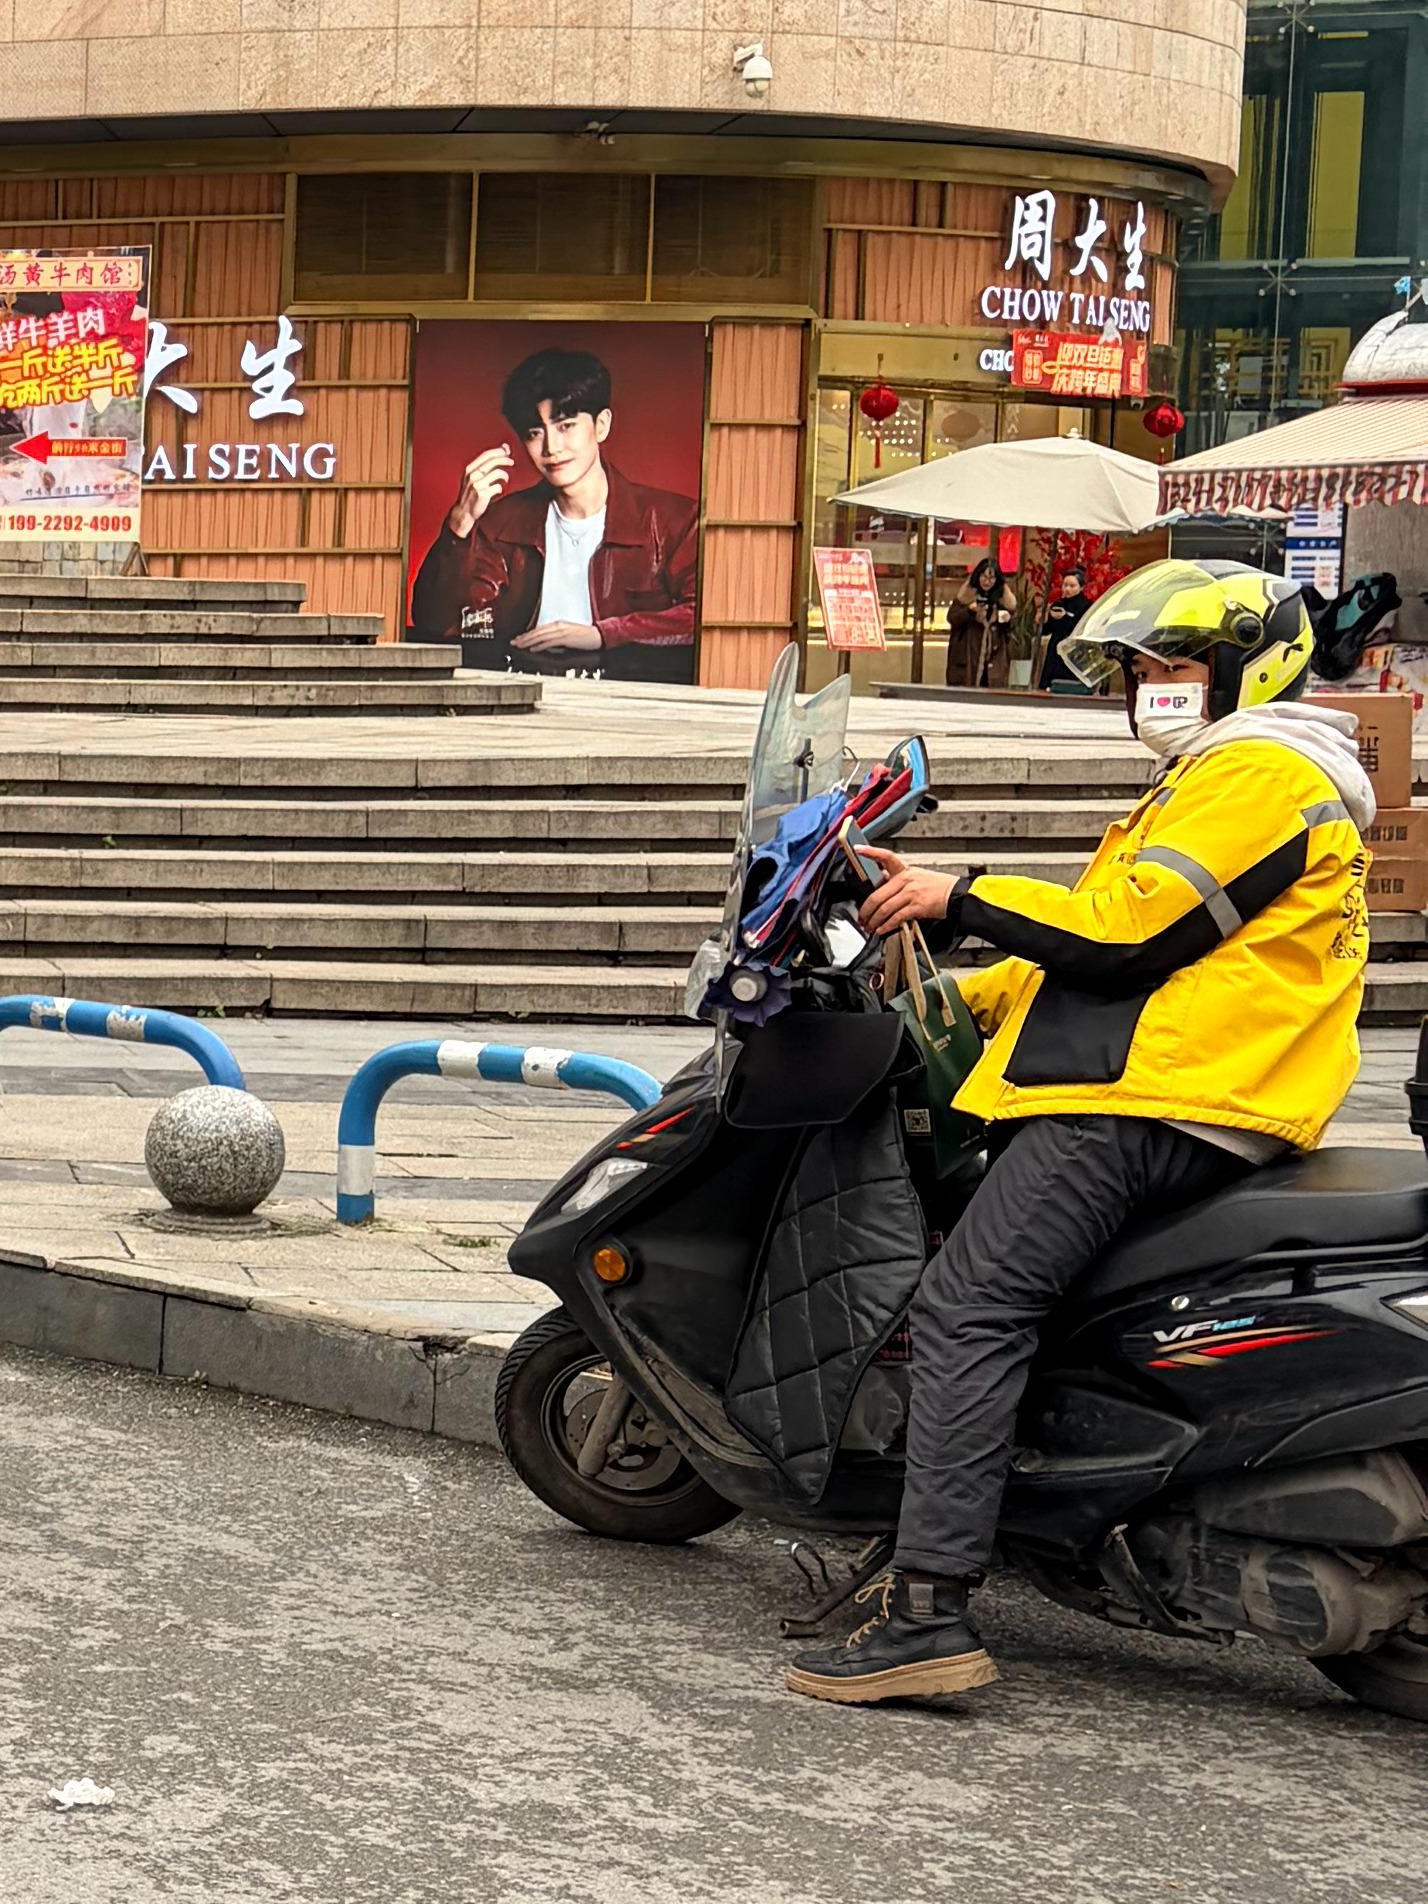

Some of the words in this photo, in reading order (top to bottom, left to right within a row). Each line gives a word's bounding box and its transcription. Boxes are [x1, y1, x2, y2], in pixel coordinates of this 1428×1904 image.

[1005, 190, 1145, 292] 周大生
[981, 285, 1063, 322] CHOW
[1070, 292, 1104, 327] TAI
[1108, 296, 1151, 333] SENG
[208, 442, 337, 481] SENG
